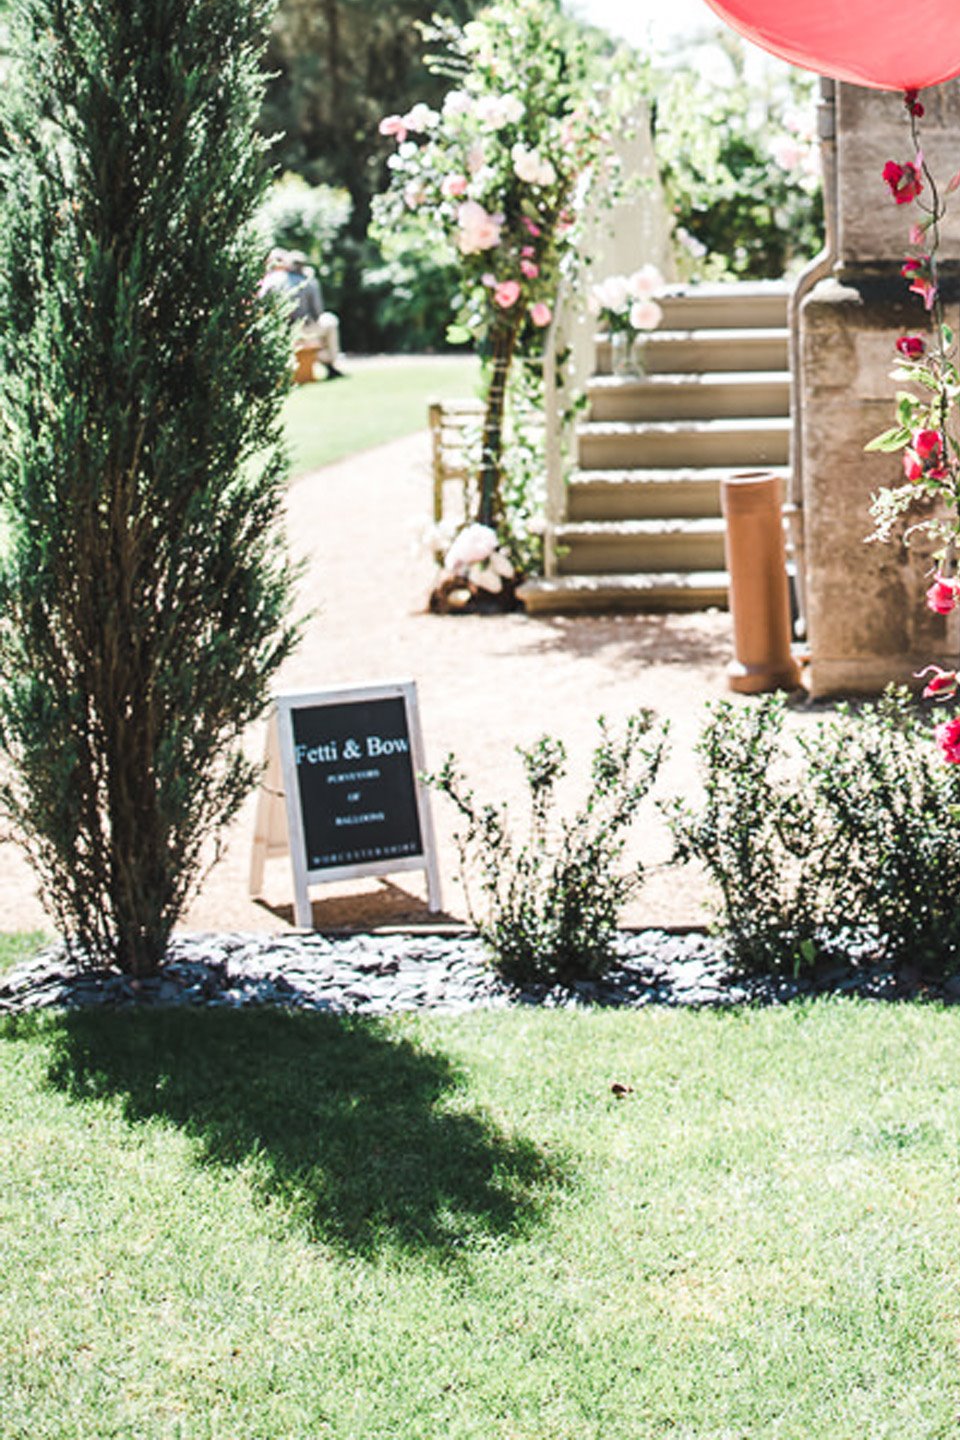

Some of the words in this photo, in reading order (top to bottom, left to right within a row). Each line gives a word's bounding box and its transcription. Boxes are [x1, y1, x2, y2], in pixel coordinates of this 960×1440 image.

[295, 740, 337, 764] Fetti
[343, 738, 362, 760] &
[367, 735, 409, 757] Bow
[335, 812, 385, 826] BALLOONS
